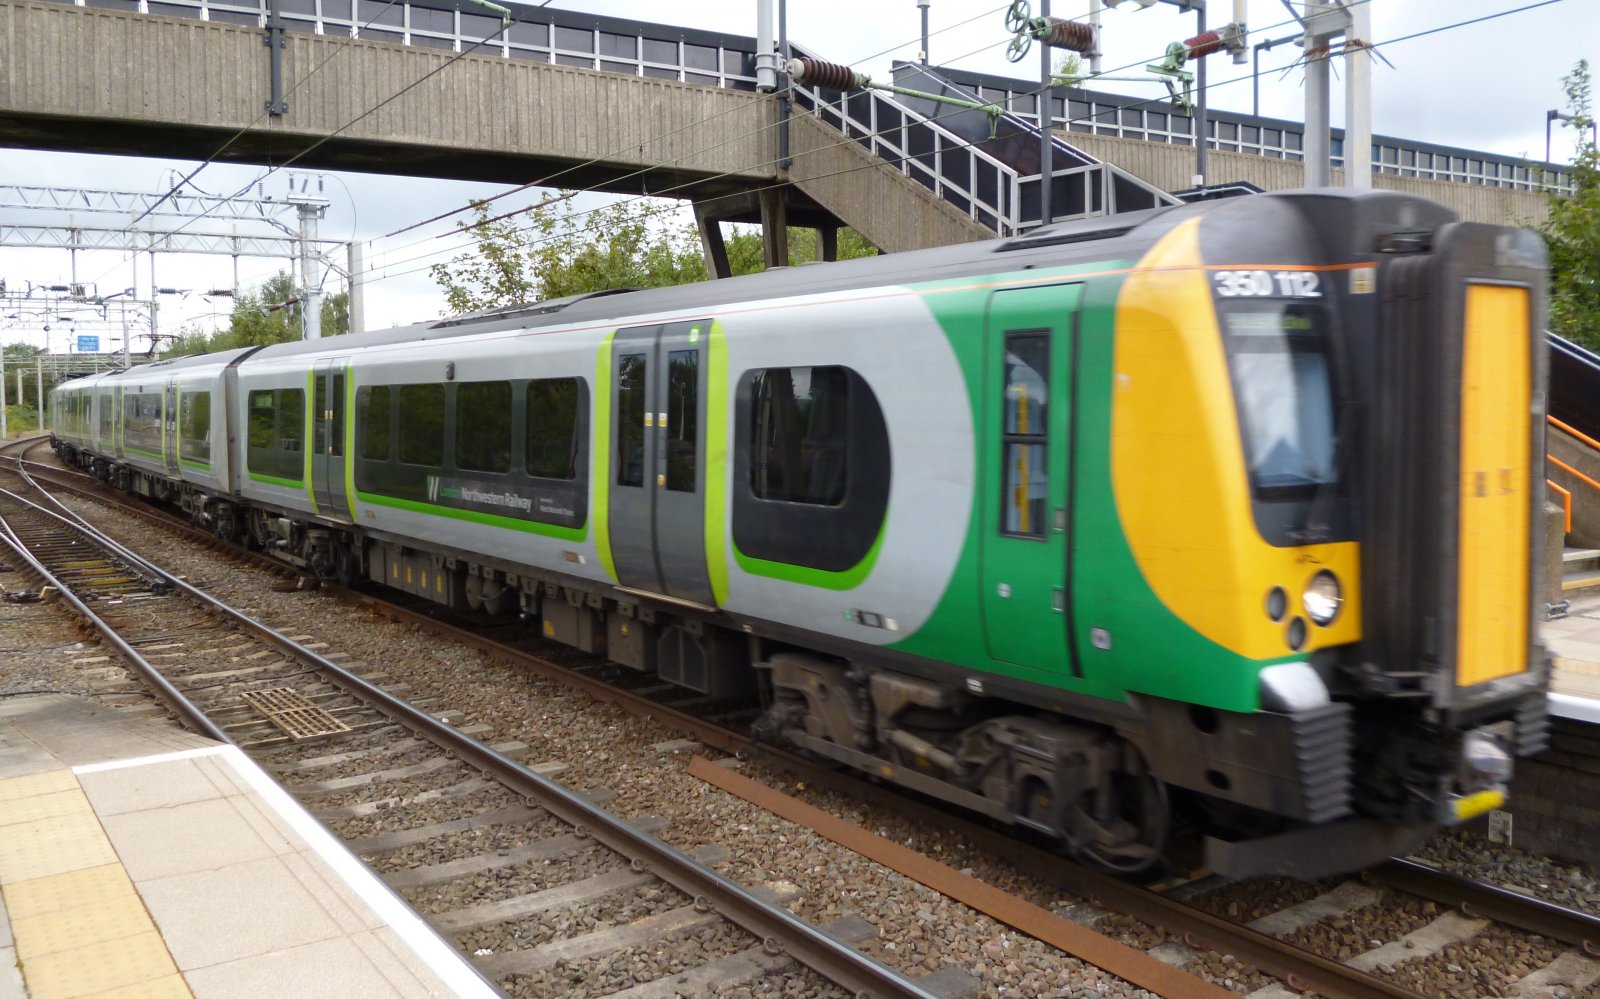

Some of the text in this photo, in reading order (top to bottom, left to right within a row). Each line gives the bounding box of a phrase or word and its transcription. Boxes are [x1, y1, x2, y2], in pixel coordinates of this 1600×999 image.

[1214, 271, 1322, 297] 350 112
[504, 492, 532, 512] Railway
